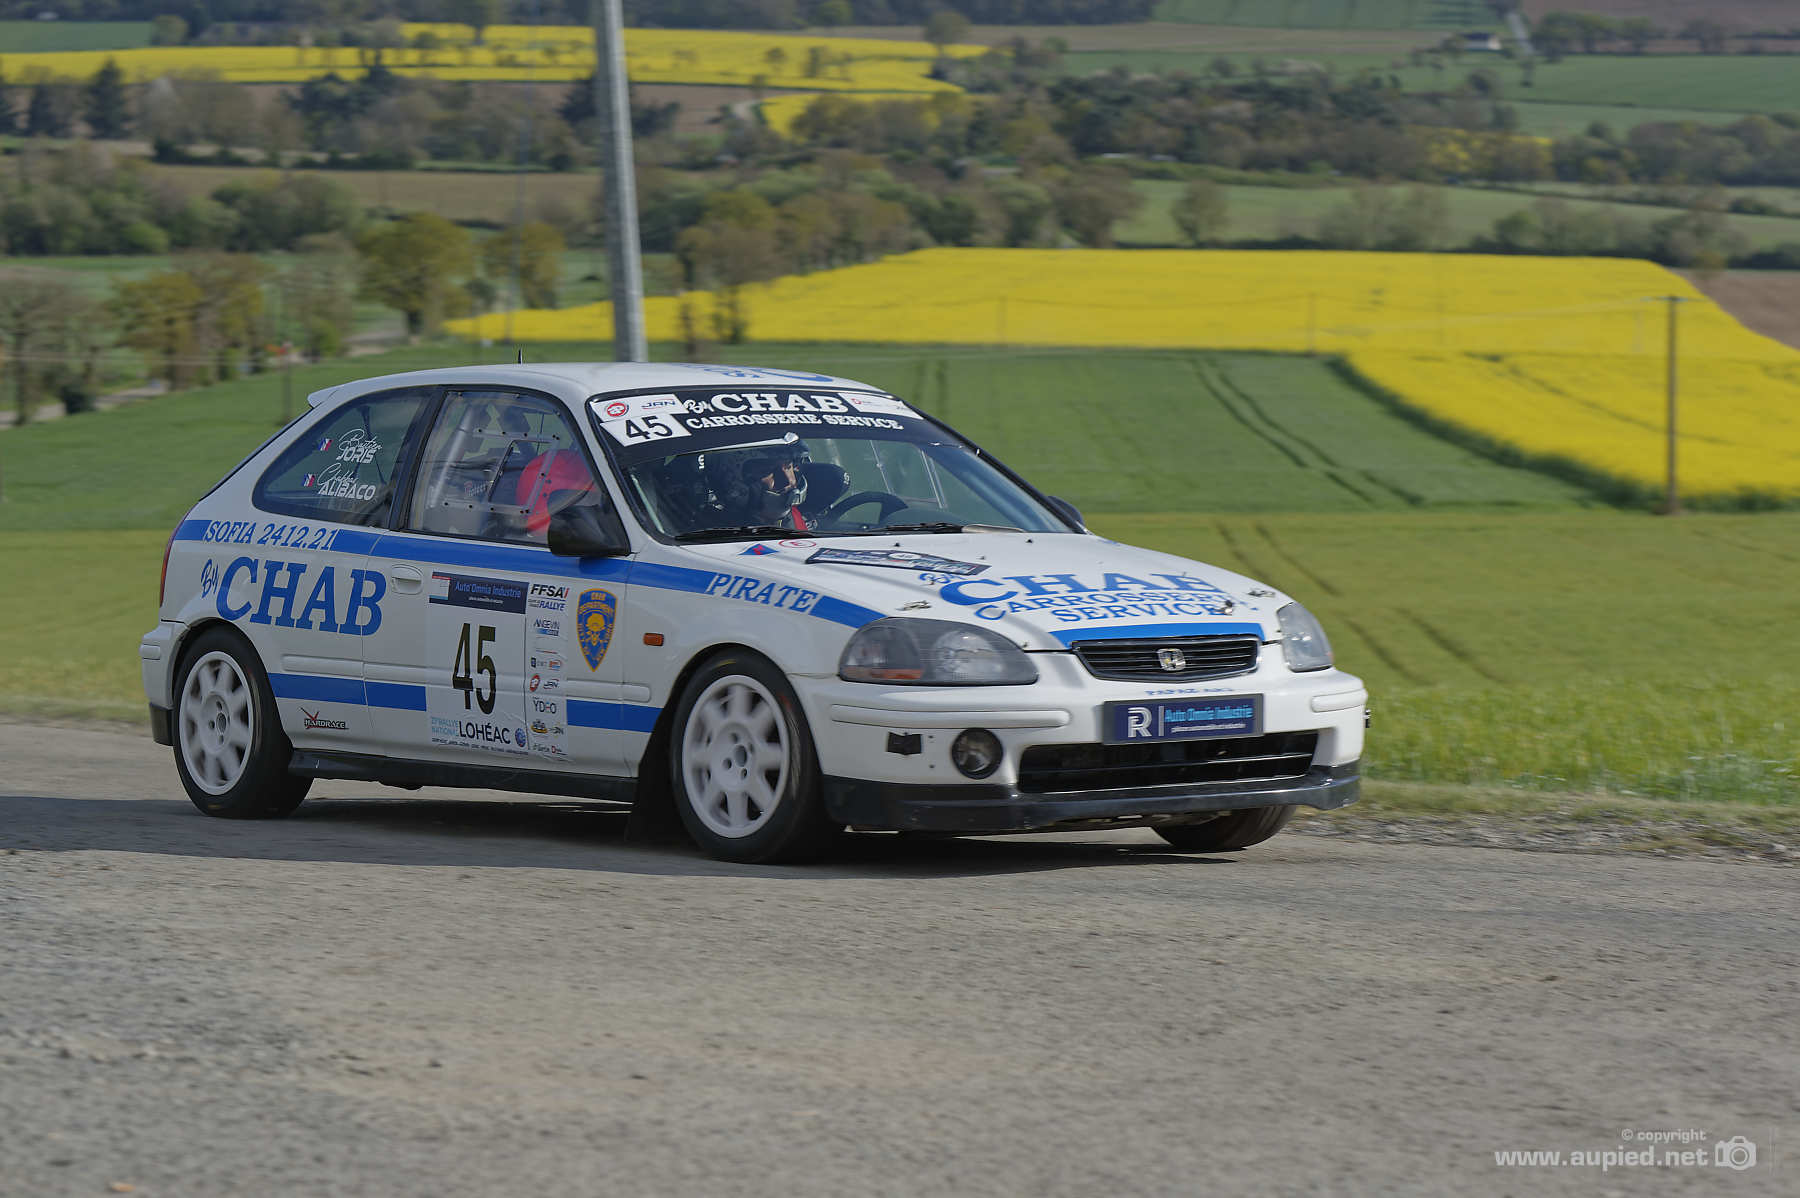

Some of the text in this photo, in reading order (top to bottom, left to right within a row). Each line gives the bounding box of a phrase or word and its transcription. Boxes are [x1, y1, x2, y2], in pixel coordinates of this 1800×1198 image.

[710, 393, 850, 413] CHAB
[626, 415, 673, 440] 45
[687, 413, 904, 430] CARROSSERIE SERVICE
[336, 446, 377, 464] JORIS
[318, 481, 377, 500] ALIBACO
[204, 520, 257, 543] SOFIA
[455, 581, 471, 592] Auto
[530, 584, 565, 599] FFSA
[705, 572, 819, 613] PIRATE
[939, 573, 1227, 606] CHAB
[215, 556, 387, 637] CHAB
[974, 590, 1242, 621] CARROSSER
[539, 601, 566, 612] RALLYE
[1052, 603, 1231, 622] SERVICE
[452, 622, 497, 715] 45
[304, 719, 346, 729] HARDRACE
[1164, 708, 1186, 722] Auto
[459, 721, 511, 745] LOHÉAC
